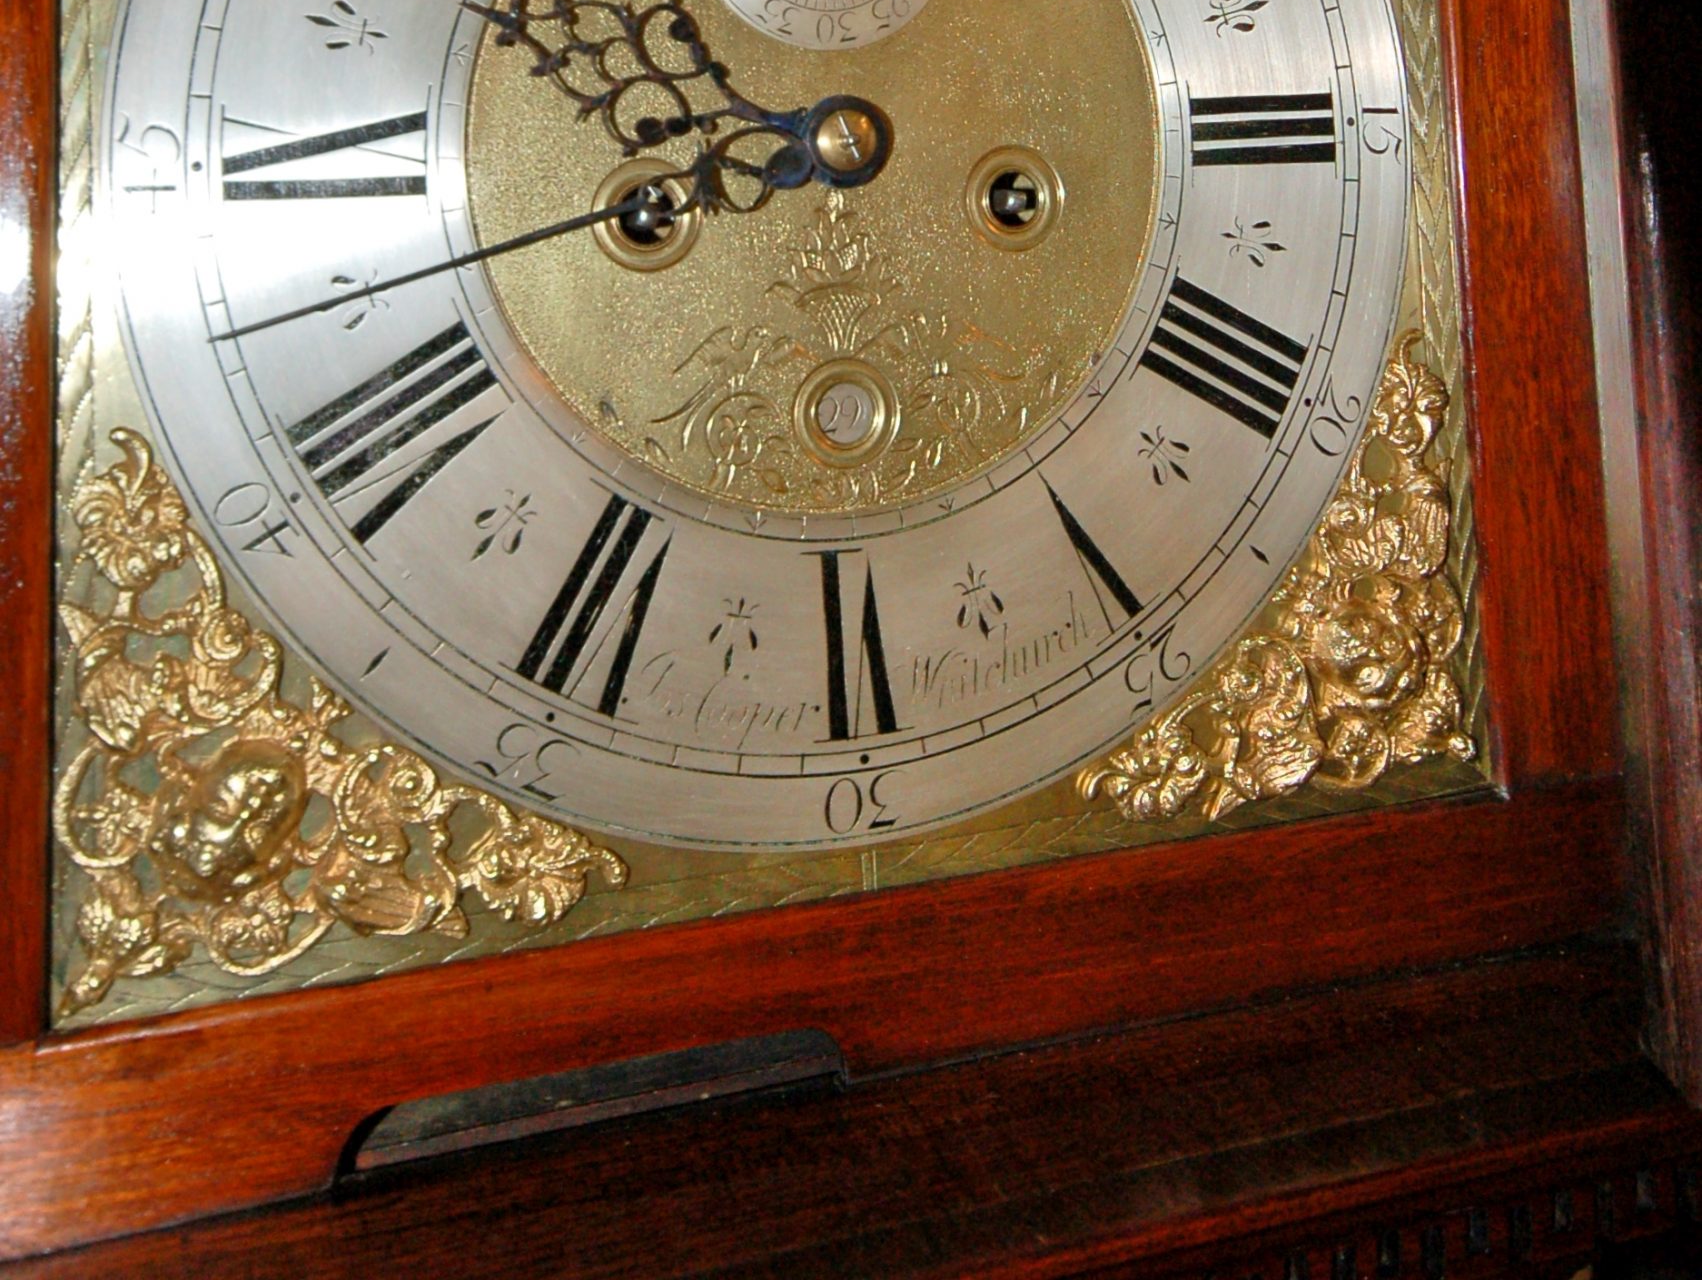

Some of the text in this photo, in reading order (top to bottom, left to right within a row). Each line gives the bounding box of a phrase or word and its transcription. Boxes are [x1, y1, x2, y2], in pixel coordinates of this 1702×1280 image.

[816, 12, 856, 42] 30
[118, 111, 181, 214] 45
[1187, 80, 1338, 187] III
[1361, 106, 1402, 162] 15
[821, 395, 862, 434] 29
[1307, 380, 1363, 458] 20
[212, 481, 302, 560] 40
[1125, 623, 1190, 713] 25
[473, 723, 581, 803] 35
[824, 770, 908, 834] 30
